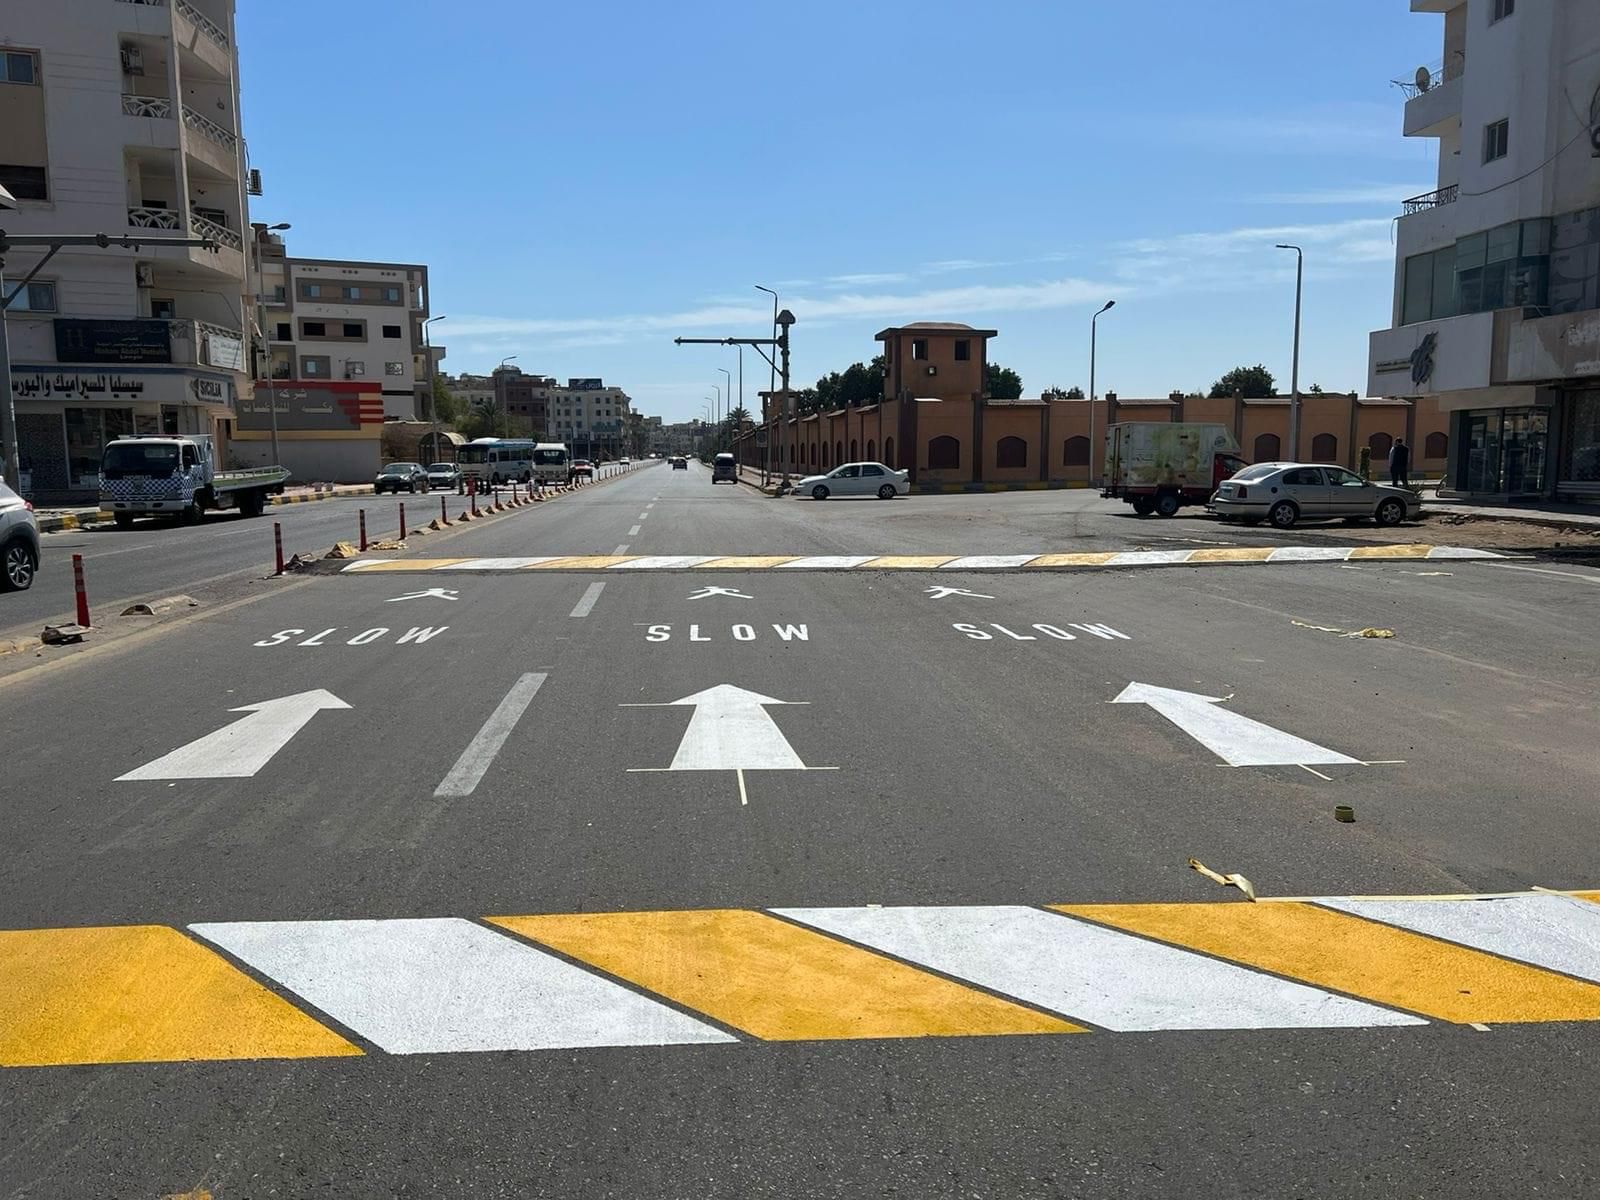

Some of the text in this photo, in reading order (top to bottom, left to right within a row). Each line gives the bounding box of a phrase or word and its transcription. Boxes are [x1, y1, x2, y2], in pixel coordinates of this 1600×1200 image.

[11, 375, 144, 399] سيسليا للسيراميك والبورس
[253, 626, 449, 646] SLOW
[646, 623, 810, 644] SLOW
[952, 622, 1132, 641] SLOW
